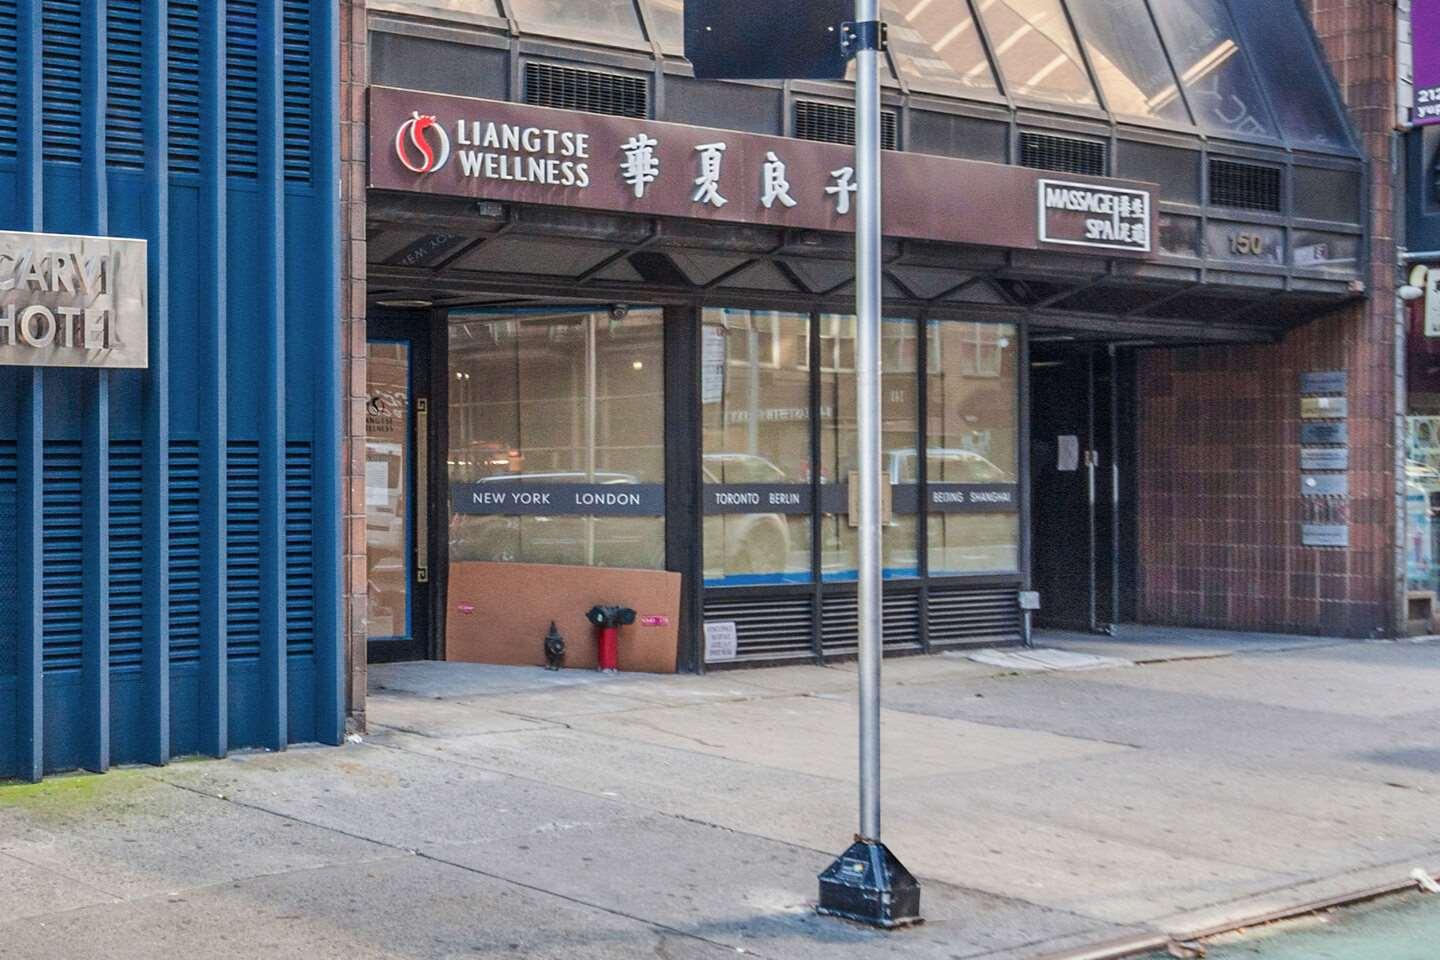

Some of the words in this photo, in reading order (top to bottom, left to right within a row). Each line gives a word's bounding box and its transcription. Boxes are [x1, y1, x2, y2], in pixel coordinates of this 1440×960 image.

[457, 119, 589, 158] LIANGTSE
[458, 150, 589, 188] WELLNESS
[1046, 188, 1114, 214] MASSAGE
[1085, 219, 1115, 240] SPA
[1227, 231, 1263, 256] 150
[472, 492, 505, 504] NEW
[512, 492, 551, 504] YORK
[575, 493, 641, 505] LONDON
[715, 493, 760, 504] TORONTO
[769, 493, 800, 504] BERLIN
